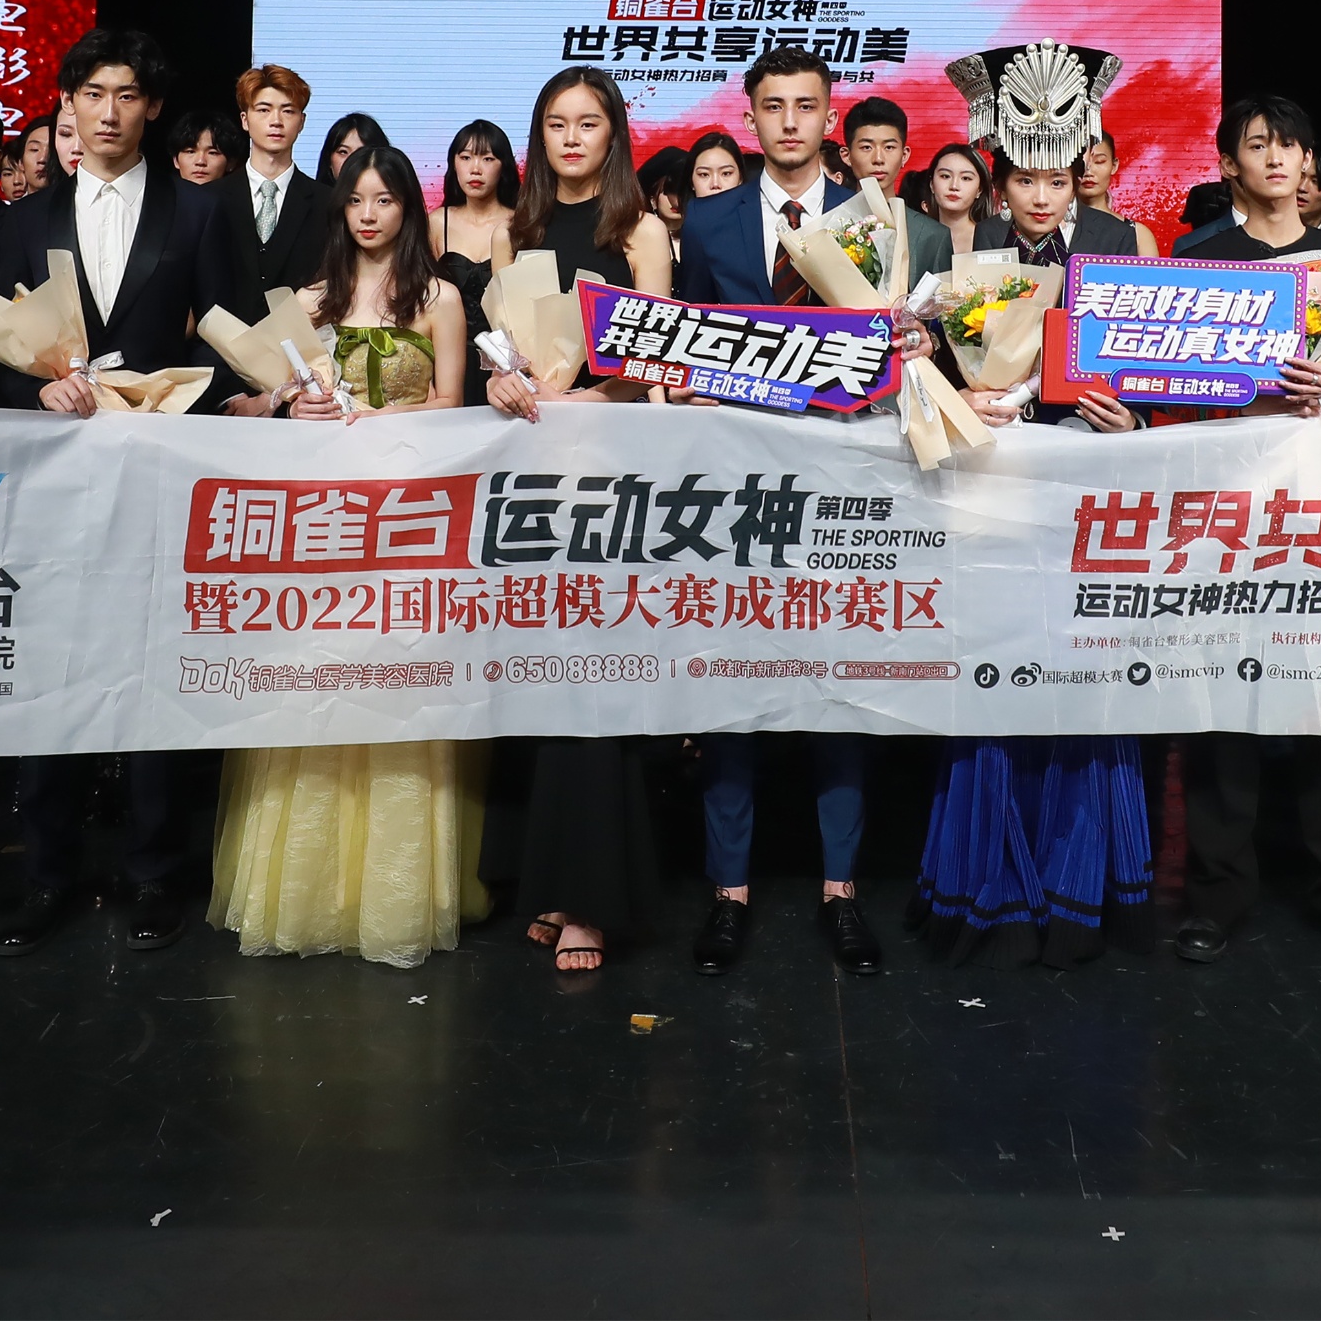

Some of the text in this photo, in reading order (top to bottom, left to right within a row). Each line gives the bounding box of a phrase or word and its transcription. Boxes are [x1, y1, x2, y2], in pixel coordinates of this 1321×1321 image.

[561, 24, 911, 64] 世界共享运动美
[609, 295, 686, 332] 世界
[1070, 282, 1277, 325] 美颜好身材
[595, 324, 669, 359] 共享
[1098, 323, 1303, 365] 运动真女神
[623, 358, 773, 405] 铜雀台 运动女神
[1121, 376, 1226, 397] 铜雀台 运动女神
[205, 471, 821, 569] 铜雀台 运动女神
[815, 495, 894, 521] 第四季
[811, 528, 947, 548] THE SPORTING
[806, 551, 898, 570] GODDESS
[182, 572, 945, 635] 暨2022国际超模大赛成都赛区
[506, 654, 660, 684] 65088888
[709, 658, 829, 678] 成都市新南路8号
[1042, 669, 1123, 685] 国际超模大赛
[1155, 662, 1225, 680] @ismcvip
